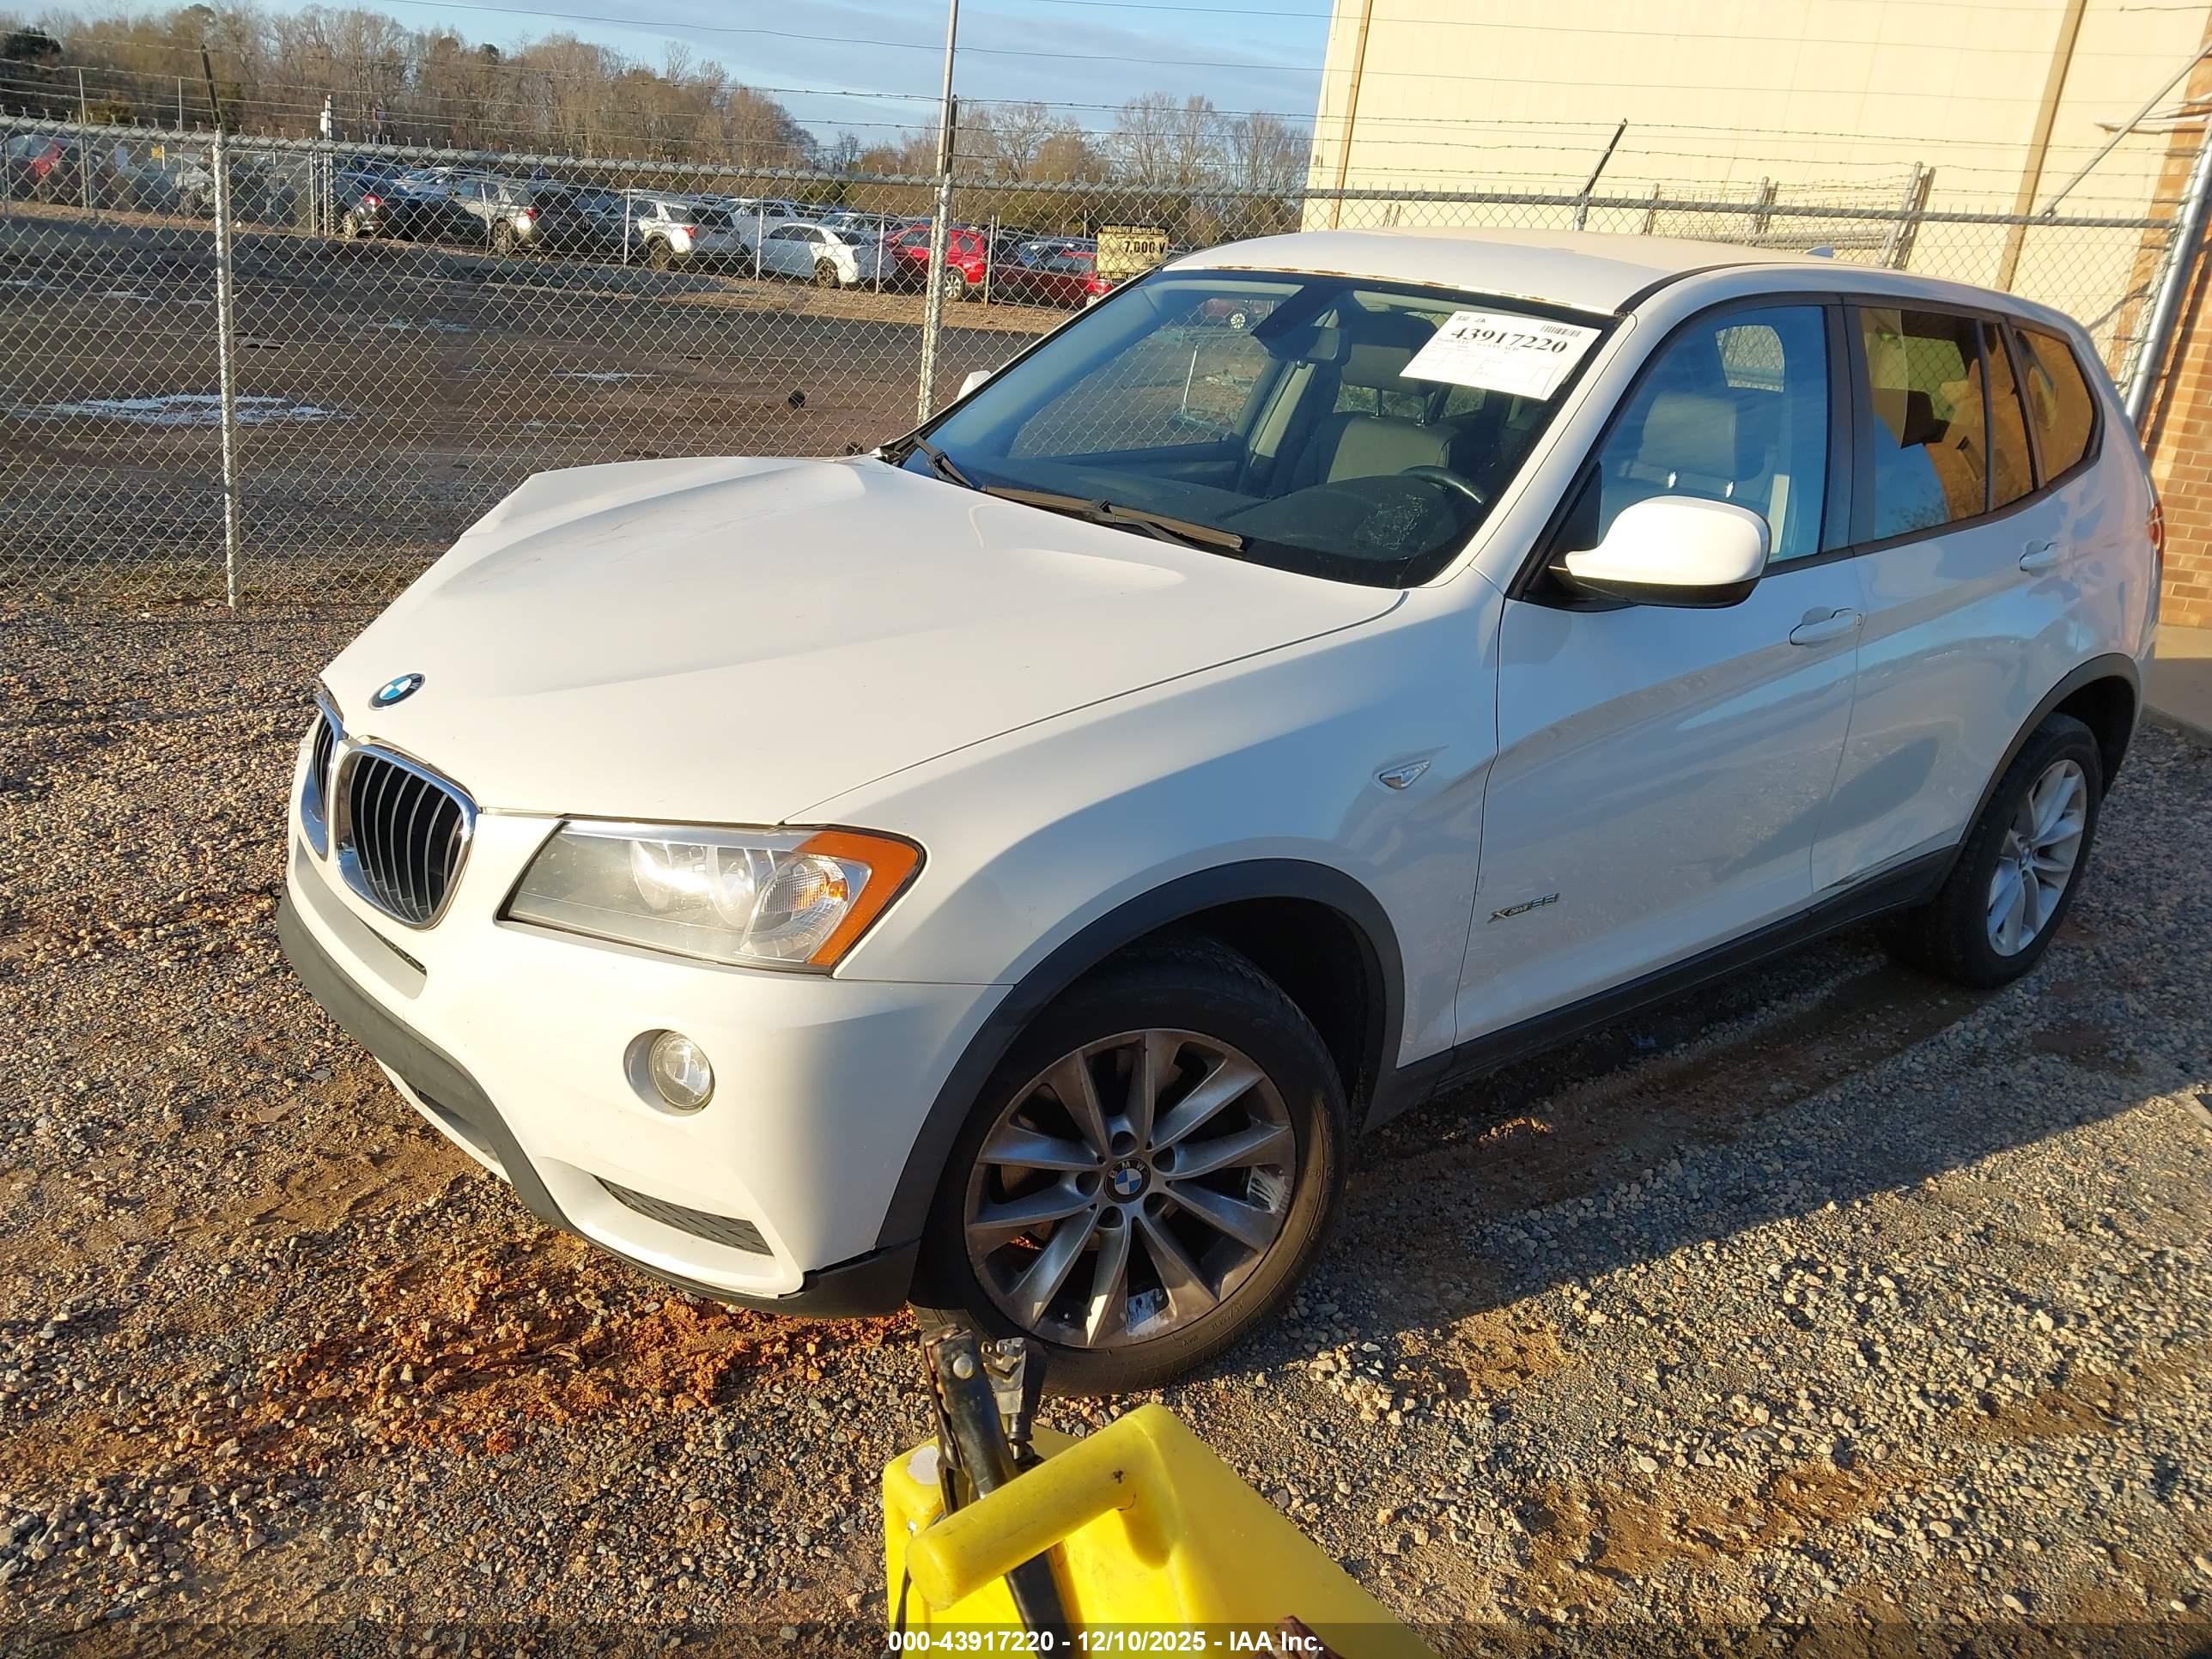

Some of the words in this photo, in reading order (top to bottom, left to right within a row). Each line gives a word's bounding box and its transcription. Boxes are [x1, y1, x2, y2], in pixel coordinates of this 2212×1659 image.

[1124, 240, 1156, 255] 7,000
[1159, 241, 1166, 254] V
[1450, 325, 1568, 354] 43917220
[1108, 1160, 1146, 1179] BMW
